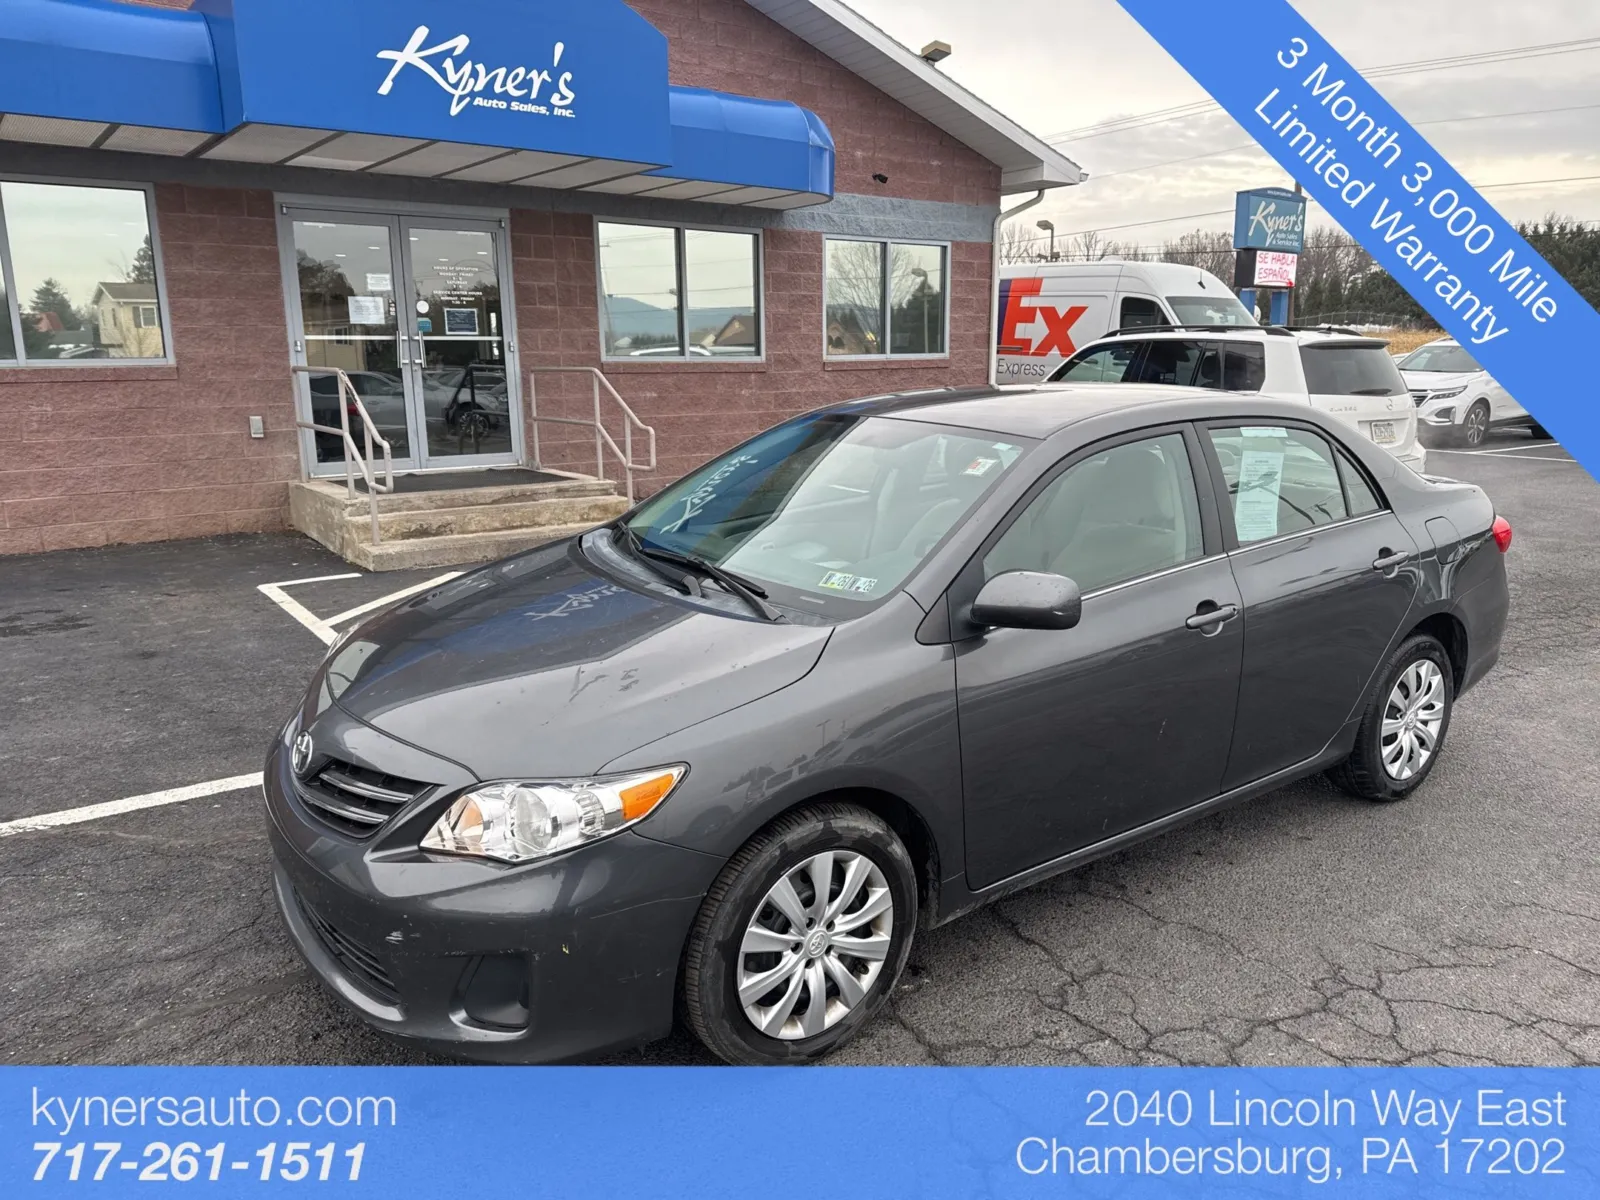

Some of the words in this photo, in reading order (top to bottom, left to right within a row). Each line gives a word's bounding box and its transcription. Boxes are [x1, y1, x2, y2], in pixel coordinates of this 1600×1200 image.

[376, 25, 575, 116] Kyner's
[473, 97, 507, 109] Auto
[511, 102, 549, 115] Sales,
[553, 105, 576, 118] Inc.
[1248, 201, 1303, 247] Kyner's
[1258, 253, 1269, 264] SE
[1271, 254, 1295, 266] HABLA
[1258, 267, 1290, 280] ESPAÑOL
[997, 358, 1046, 377] Express
